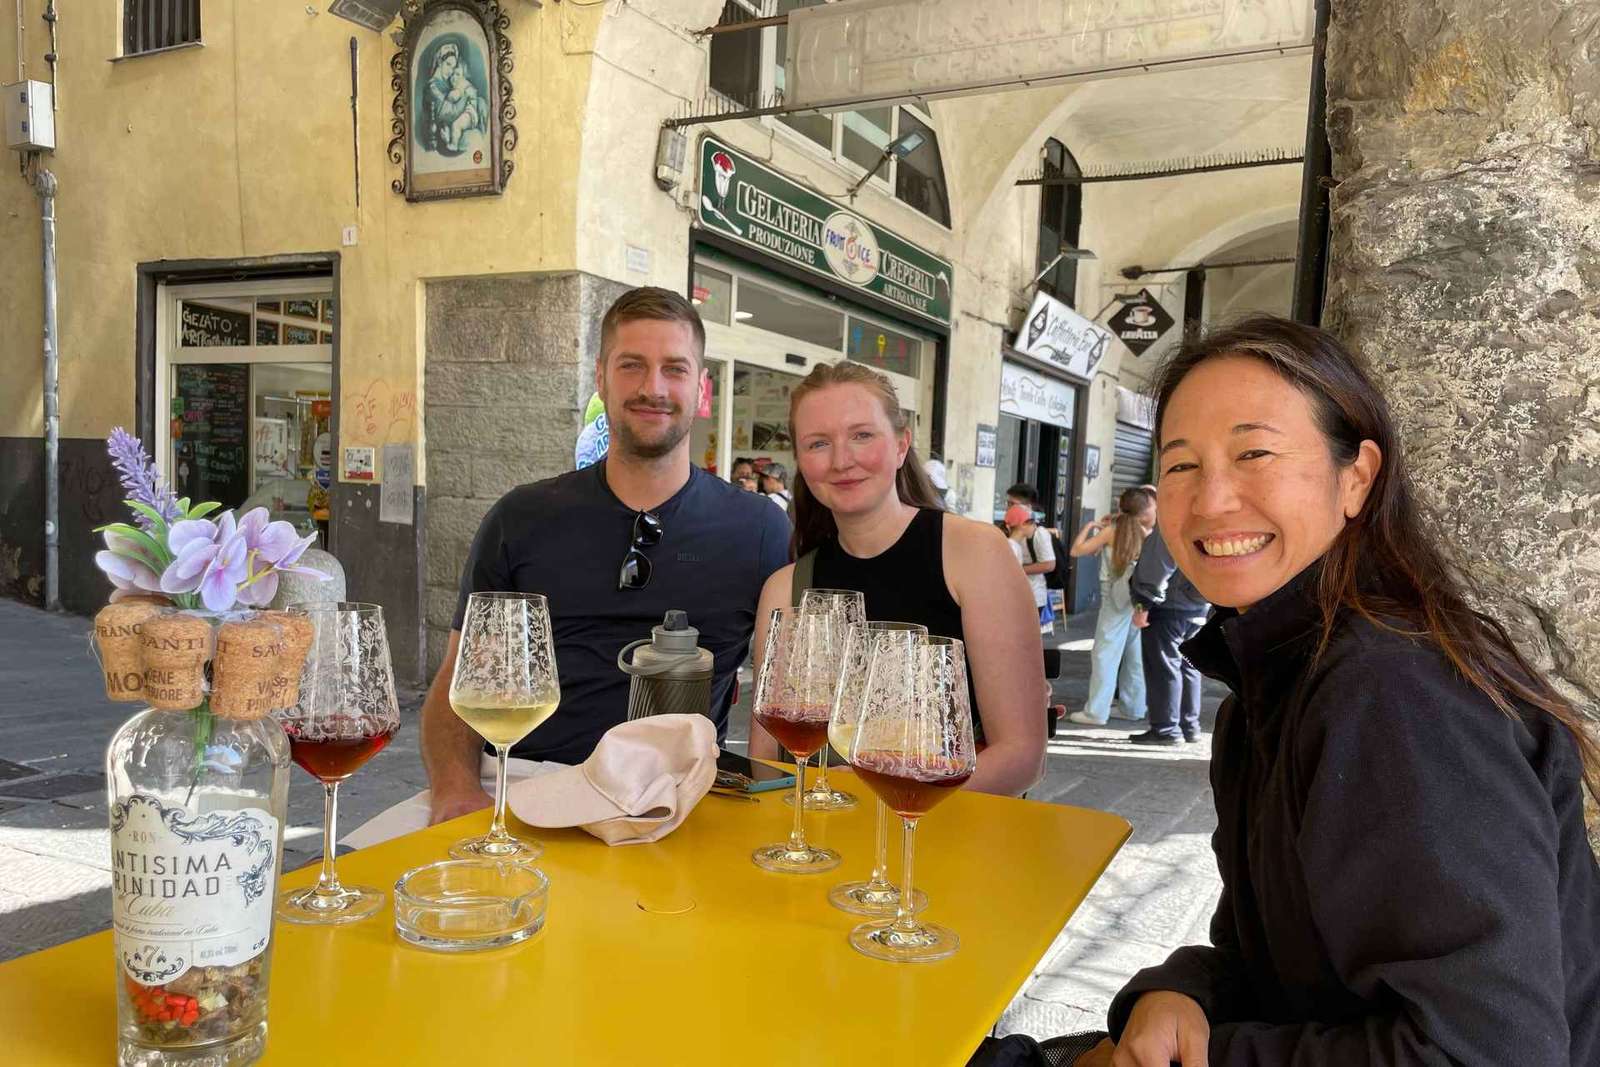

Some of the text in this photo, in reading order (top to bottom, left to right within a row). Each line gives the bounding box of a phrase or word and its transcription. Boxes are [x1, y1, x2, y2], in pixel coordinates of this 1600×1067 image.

[745, 185, 820, 245] GELATERIA
[749, 223, 815, 264] PRODUZIONE
[826, 228, 845, 250] FRUIT
[883, 250, 930, 294] CREPERIA
[183, 307, 232, 332] GELATO
